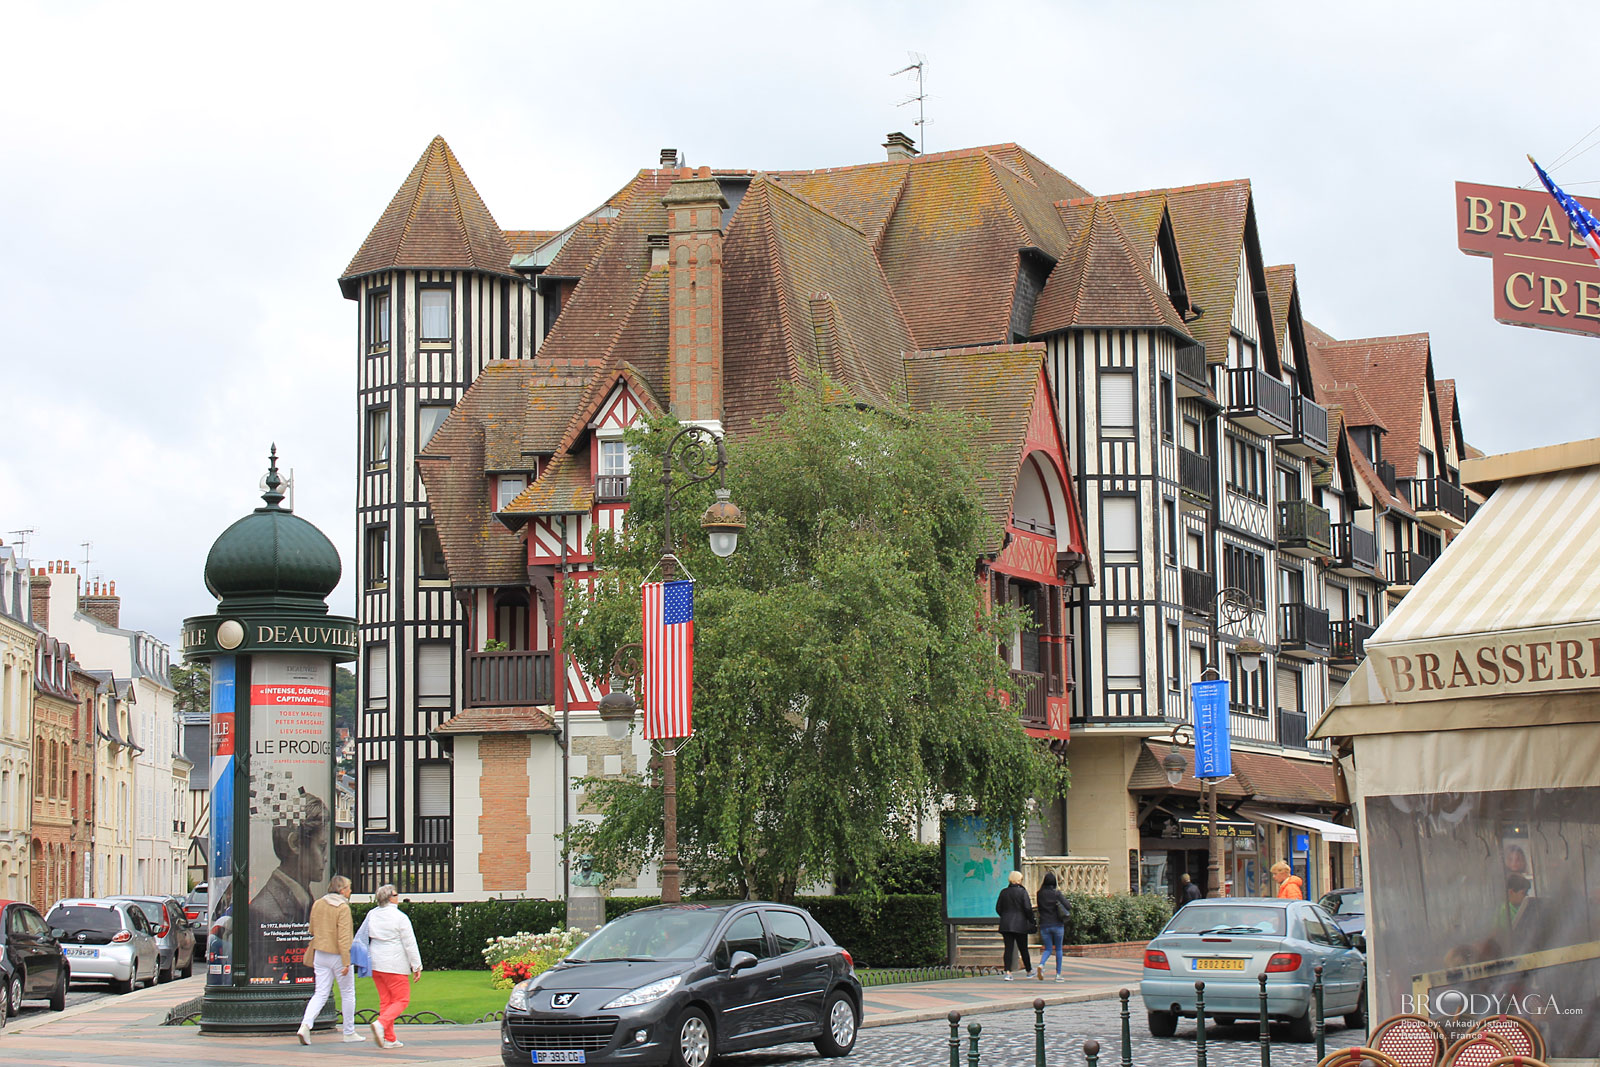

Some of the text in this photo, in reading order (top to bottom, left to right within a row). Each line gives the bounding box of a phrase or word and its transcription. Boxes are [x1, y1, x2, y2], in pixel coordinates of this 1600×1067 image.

[257, 625, 358, 648] DEAUVILLE
[255, 740, 274, 754] LE
[1201, 703, 1214, 773] DEAUVILLE
[268, 955, 279, 964] LE
[280, 955, 291, 963] 16
